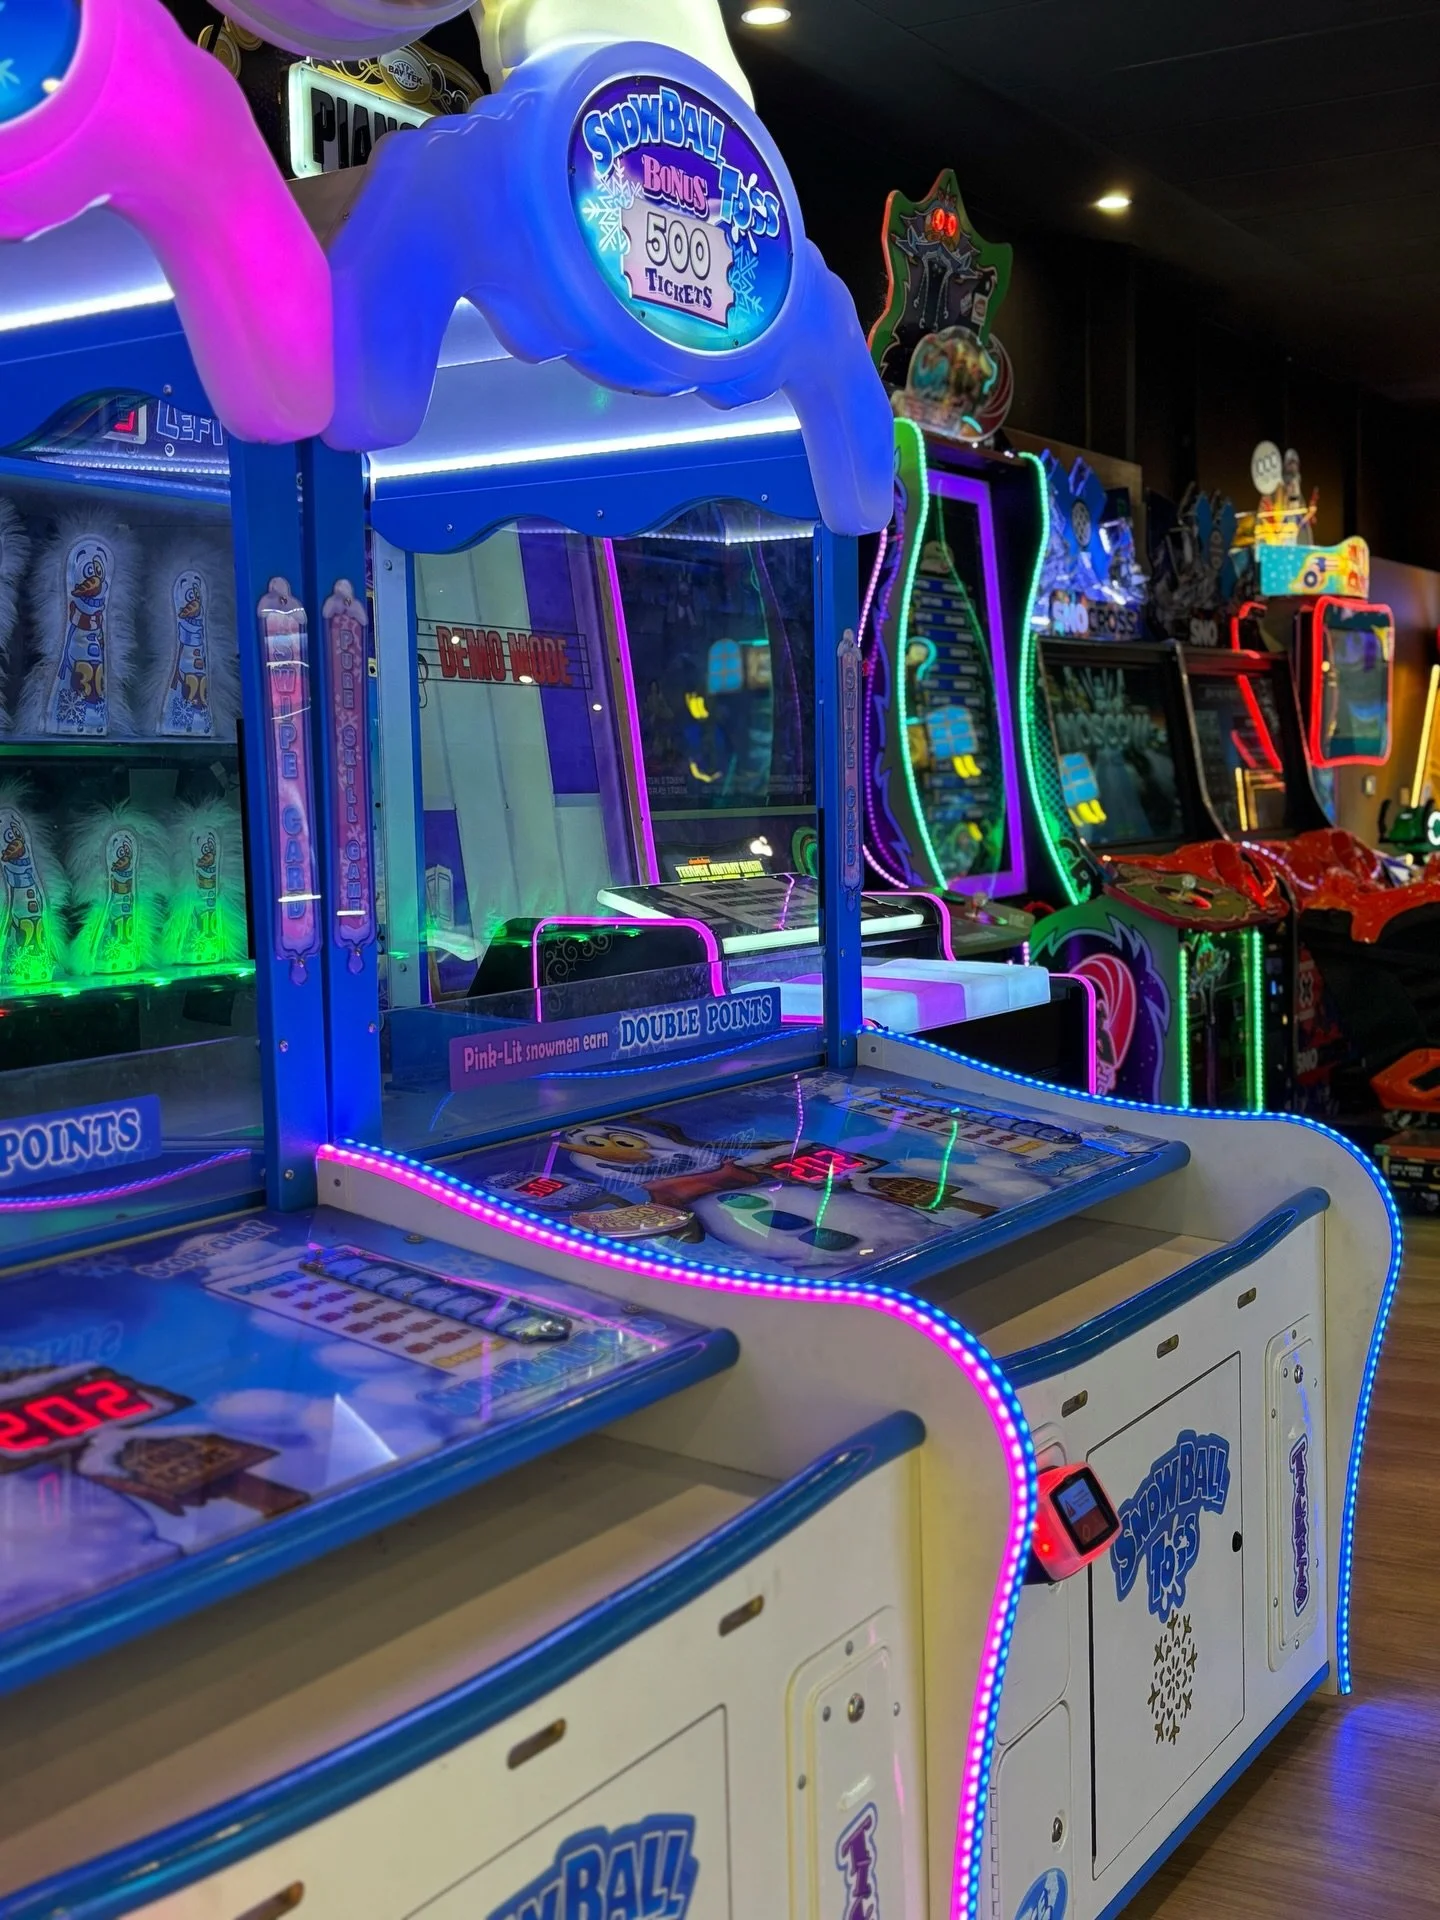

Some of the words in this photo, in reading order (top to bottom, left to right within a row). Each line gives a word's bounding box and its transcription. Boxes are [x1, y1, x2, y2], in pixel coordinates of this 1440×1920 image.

[388, 64, 405, 77] BAY
[406, 72, 423, 86] TEK
[583, 86, 726, 177] SNOWBALL
[642, 154, 708, 214] BONUS
[719, 163, 780, 238] TOSS
[645, 211, 711, 280] 500
[645, 267, 712, 308] TICKETS
[339, 629, 355, 709] PURE
[435, 626, 507, 682] DEMO
[507, 632, 574, 687] MODE
[272, 634, 298, 779] SWIPE
[342, 725, 358, 823] SKILL
[282, 804, 307, 919] CARD
[463, 1039, 523, 1073] Pink-Lit
[525, 1037, 580, 1061] snowmen
[583, 1031, 609, 1051] earn
[619, 1007, 699, 1050] DOUBLE
[706, 996, 773, 1034] POINTS
[0, 1110, 141, 1176] POINTS
[1114, 1441, 1226, 1591] SNOWBALL
